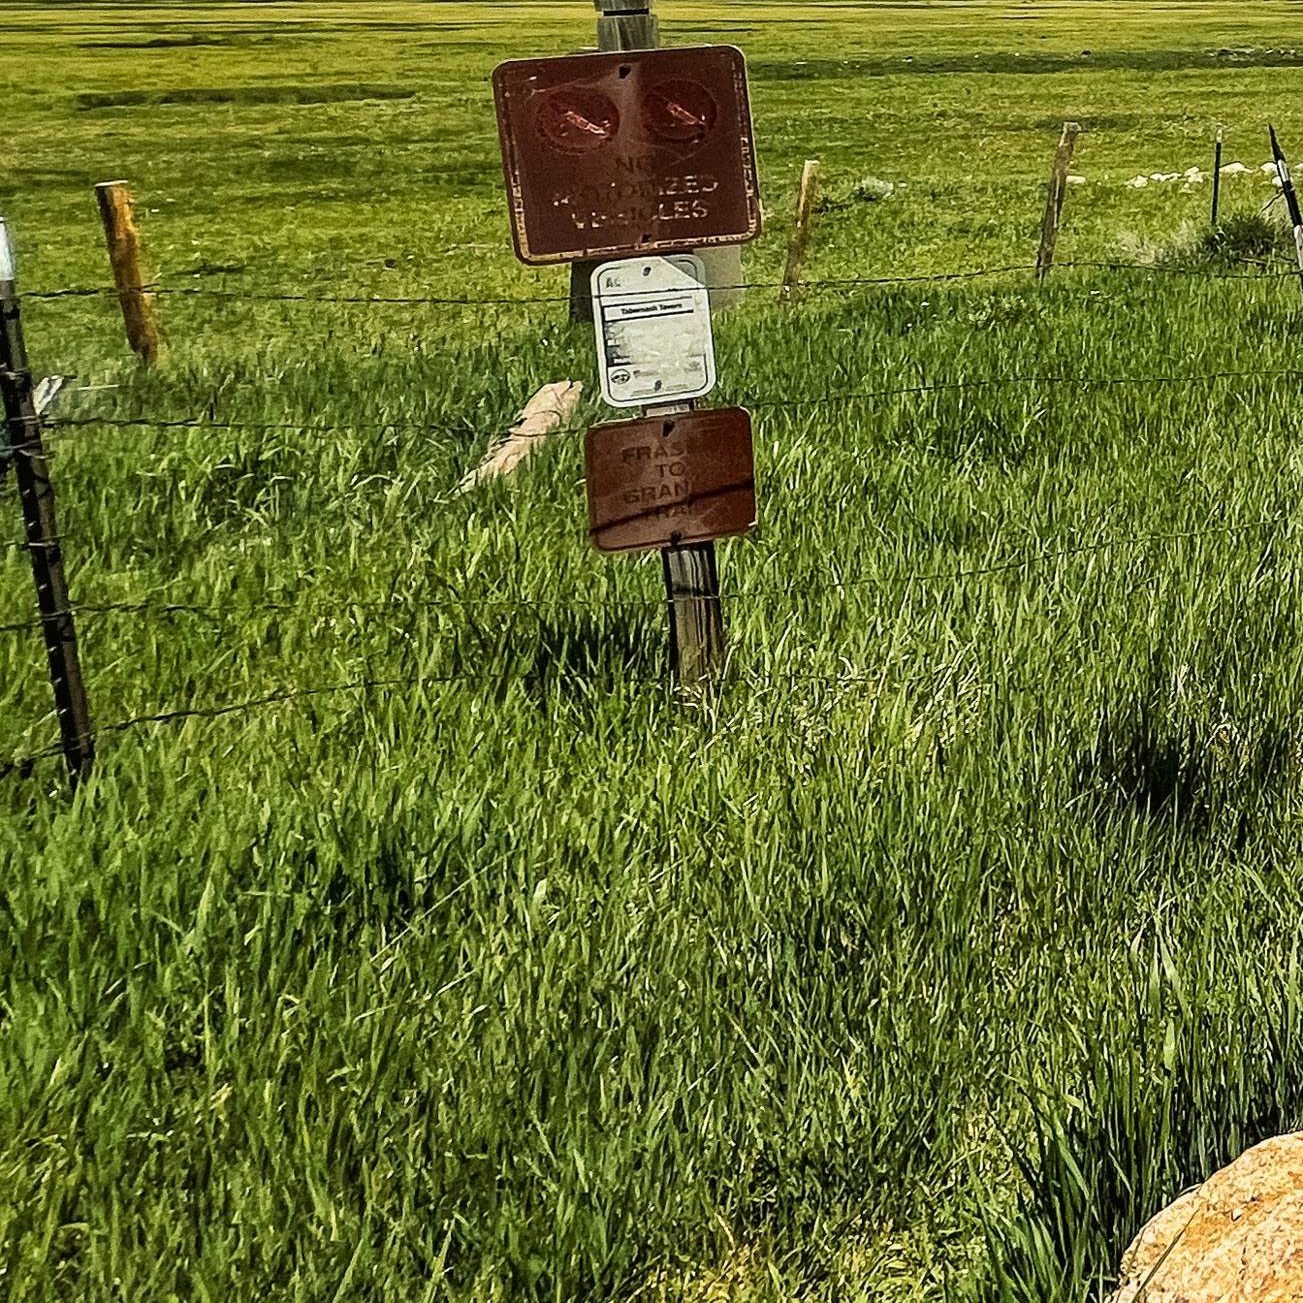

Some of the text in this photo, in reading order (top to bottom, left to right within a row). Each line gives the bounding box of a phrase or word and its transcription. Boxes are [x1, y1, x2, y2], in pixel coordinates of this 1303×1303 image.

[621, 441, 688, 462] FRAS
[655, 461, 686, 478] TO
[623, 480, 691, 504] GRAN
